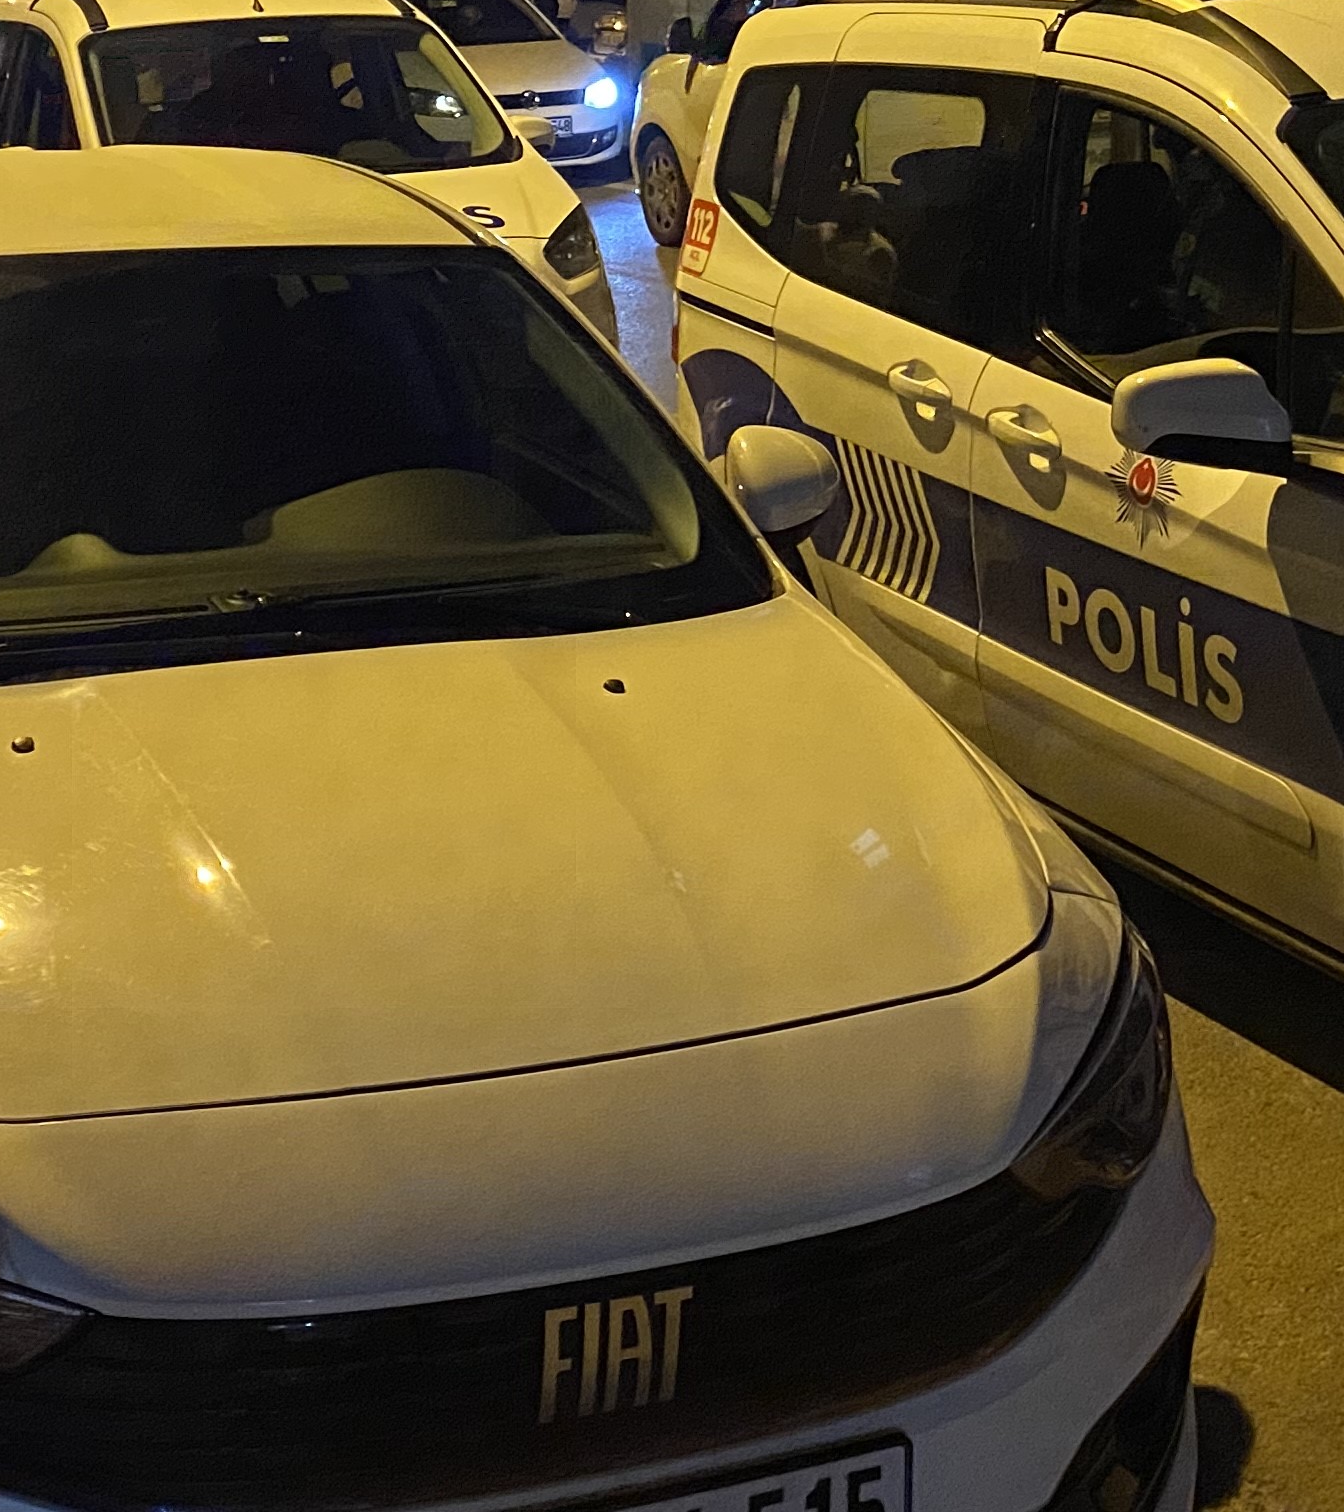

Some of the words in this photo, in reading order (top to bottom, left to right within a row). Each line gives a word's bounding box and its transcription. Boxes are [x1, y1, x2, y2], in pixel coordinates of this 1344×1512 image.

[691, 207, 715, 245] 112
[1045, 567, 1244, 724] POLİS
[539, 1286, 694, 1424] FIAT
